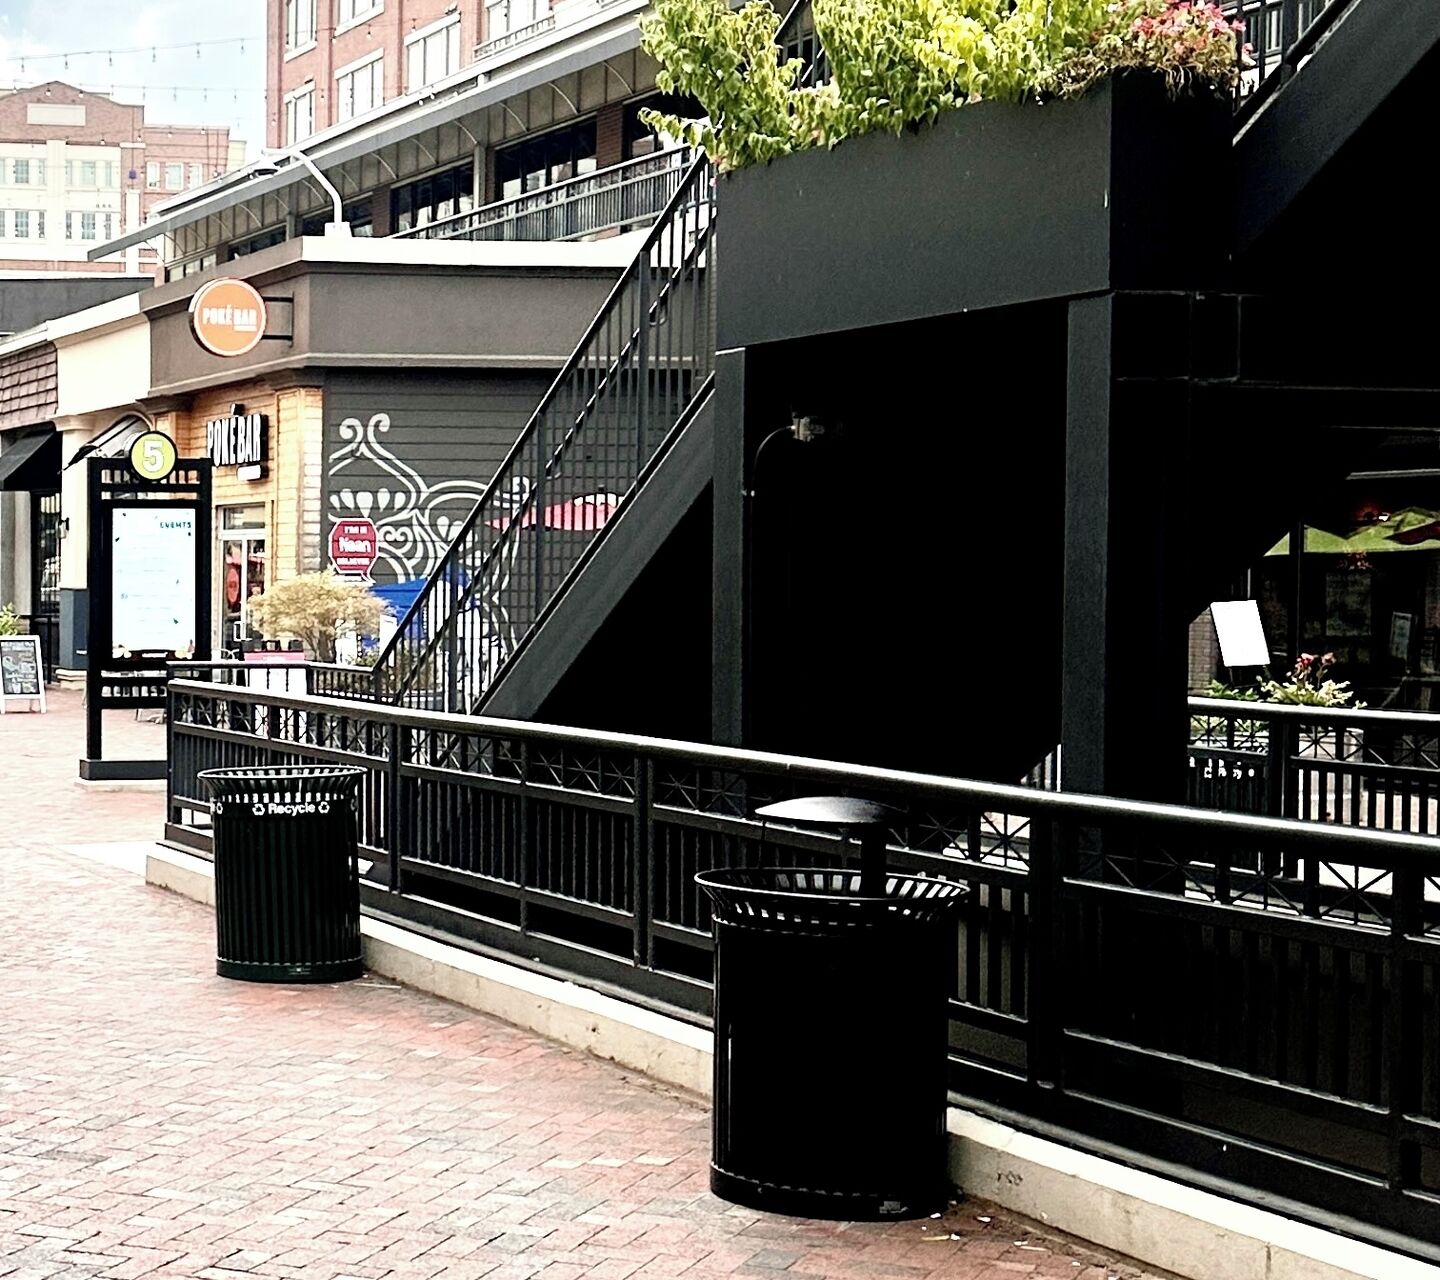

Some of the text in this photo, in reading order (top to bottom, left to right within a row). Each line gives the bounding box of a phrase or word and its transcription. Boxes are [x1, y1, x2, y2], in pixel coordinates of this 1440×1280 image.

[202, 304, 257, 326] POKÉ BAR
[237, 413, 261, 463] BAR
[142, 439, 165, 473] 5
[268, 803, 316, 817] Recycle
